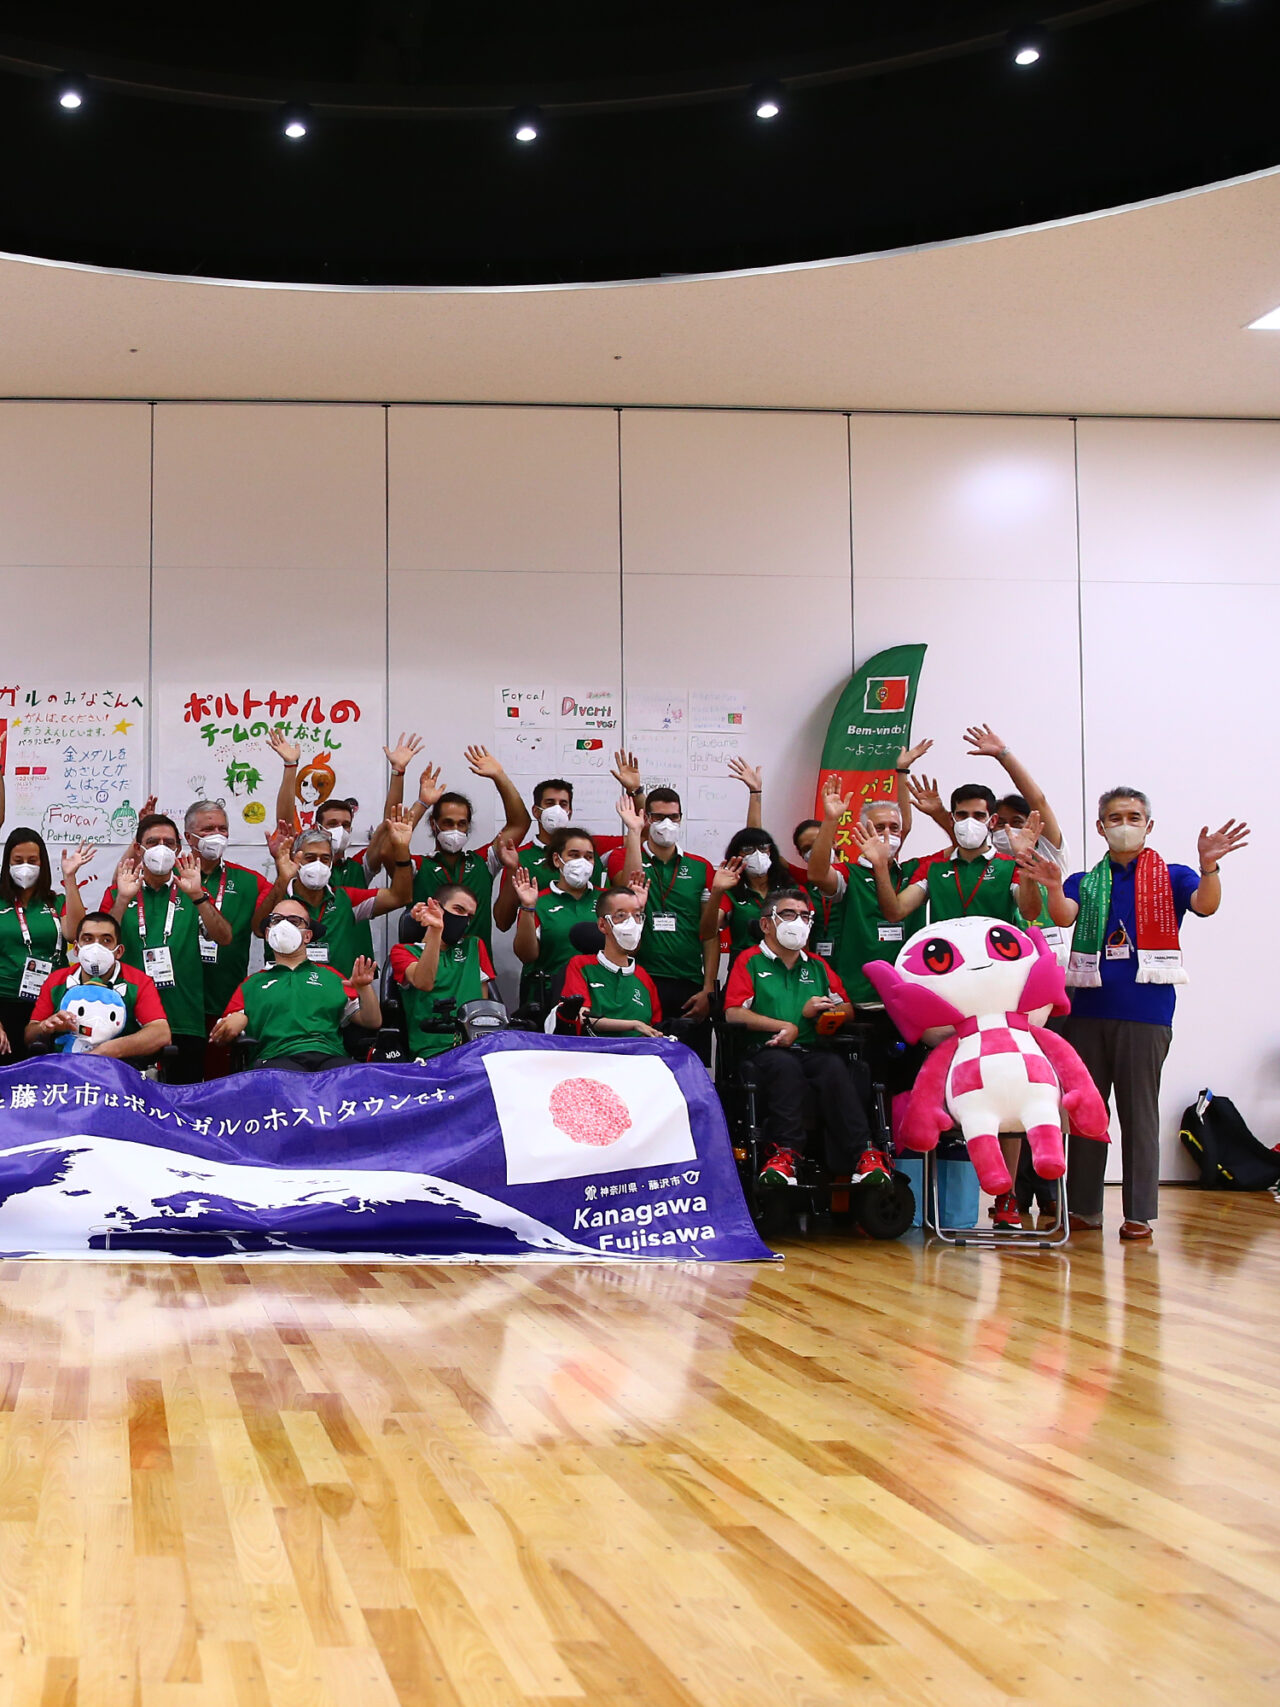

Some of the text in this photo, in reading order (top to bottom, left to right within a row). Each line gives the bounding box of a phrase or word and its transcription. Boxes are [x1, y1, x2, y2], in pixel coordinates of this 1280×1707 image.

[184, 689, 361, 724] ポルトガルの
[573, 1196, 707, 1230] Kanagawa
[599, 1225, 716, 1252] Fujisawa
